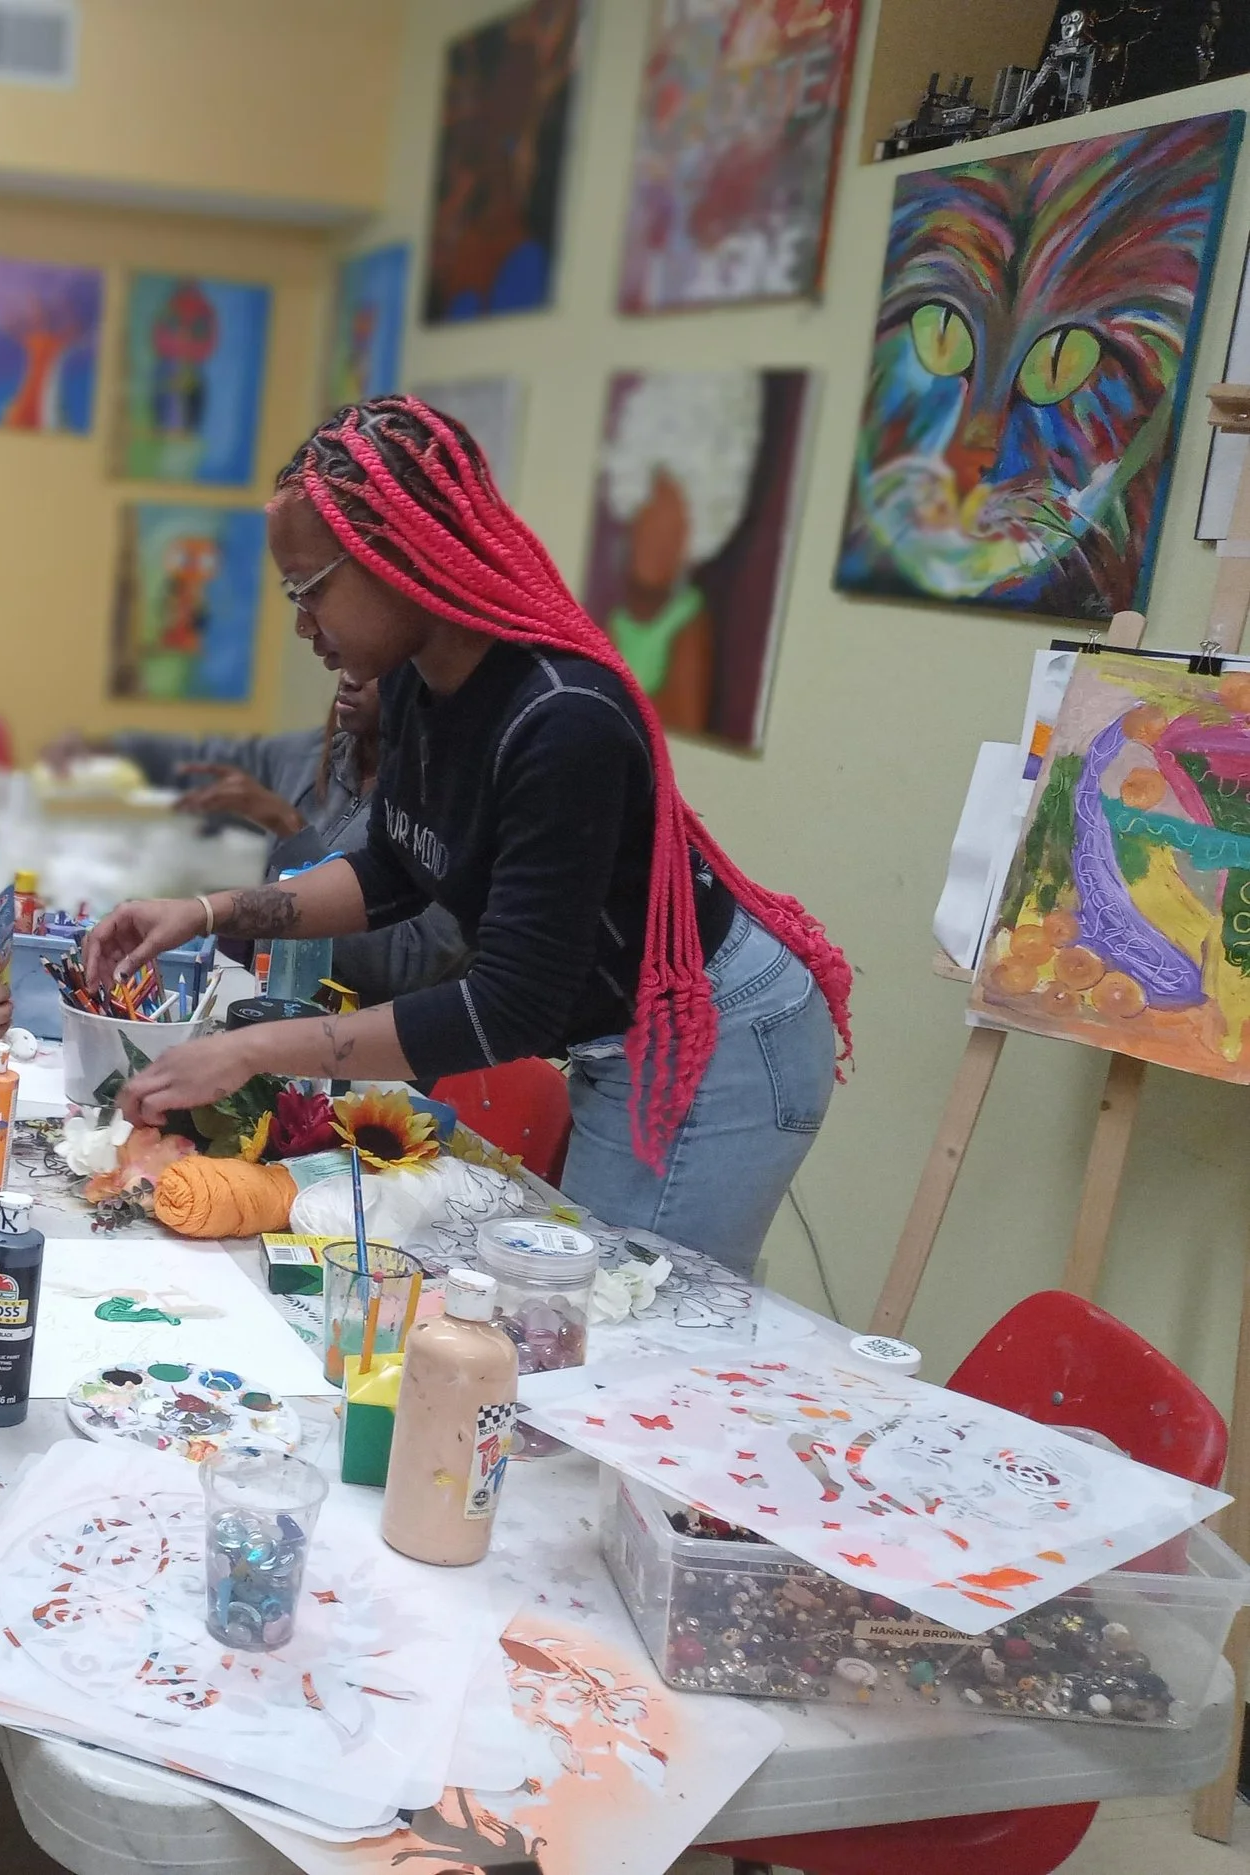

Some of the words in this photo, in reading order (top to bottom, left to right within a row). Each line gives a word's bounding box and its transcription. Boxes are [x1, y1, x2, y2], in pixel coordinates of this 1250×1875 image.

[6, 1395, 16, 1404] ml
[479, 1426, 495, 1437] Rich
[495, 1420, 507, 1431] Art
[869, 1626, 919, 1637] HANNAH
